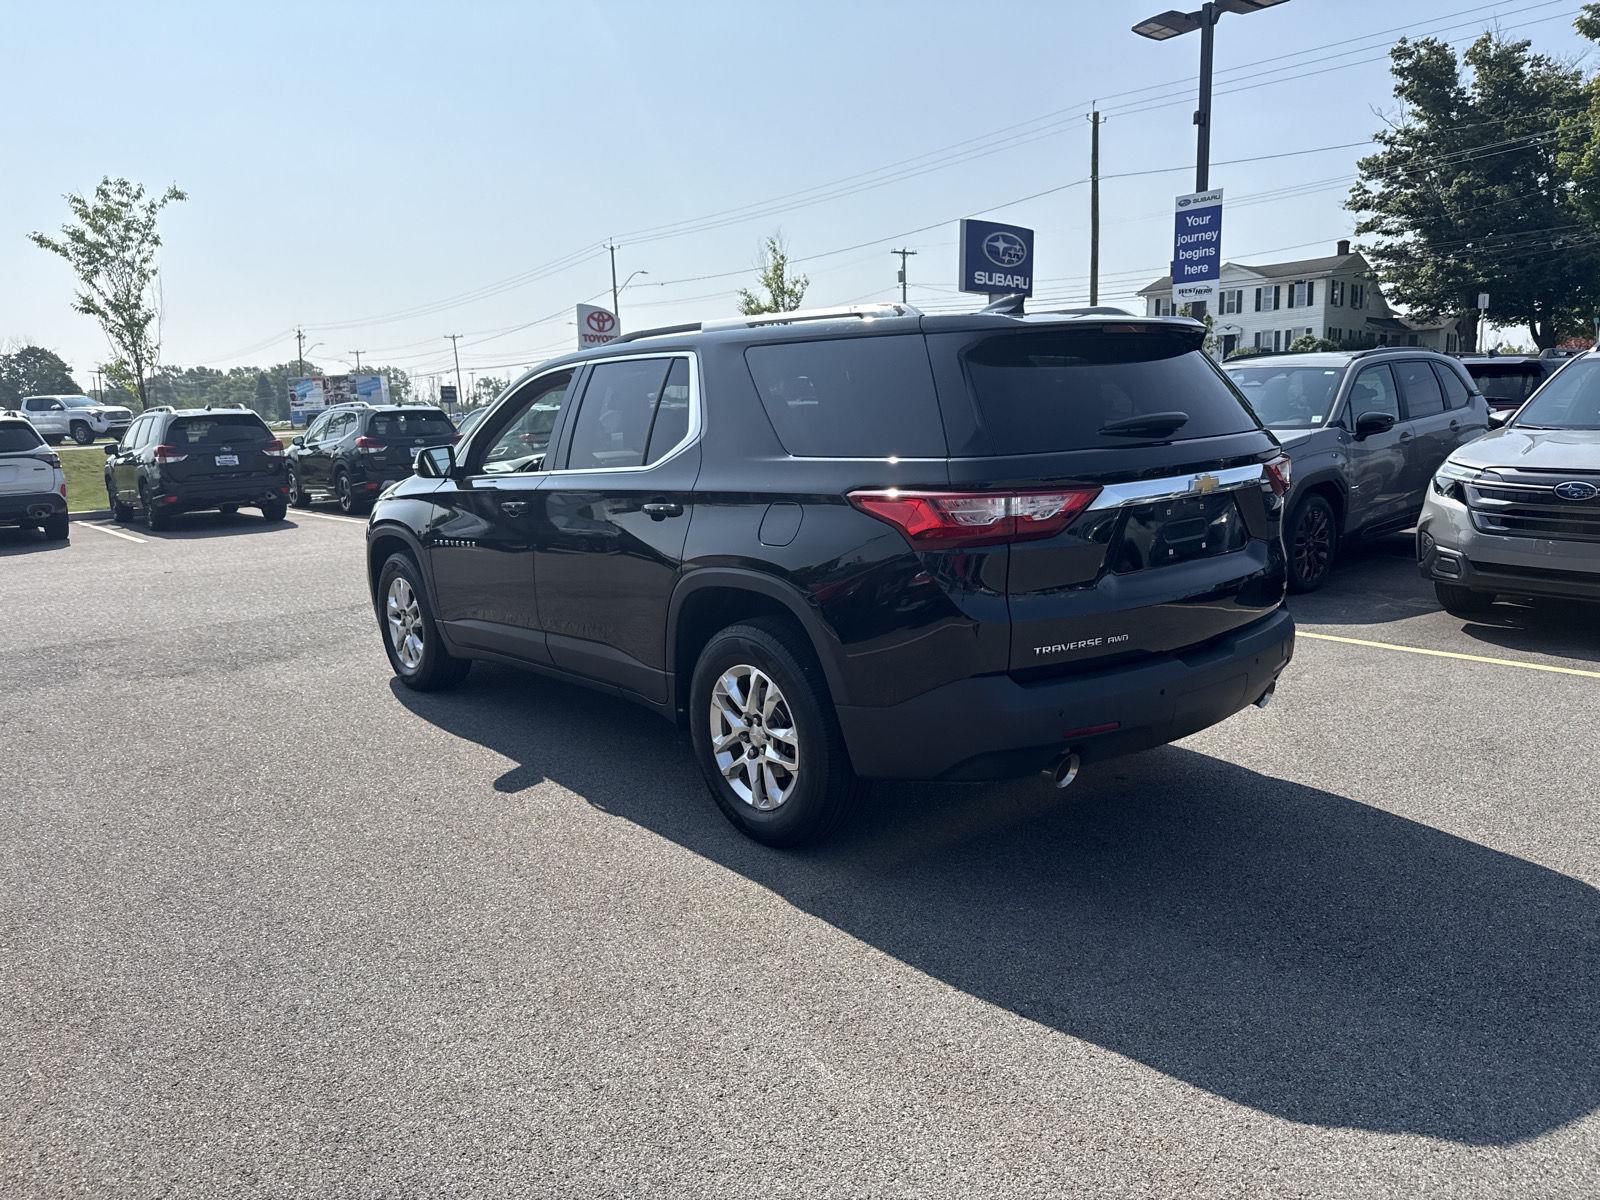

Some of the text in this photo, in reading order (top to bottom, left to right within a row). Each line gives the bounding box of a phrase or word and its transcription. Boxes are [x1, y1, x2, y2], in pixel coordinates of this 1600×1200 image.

[1192, 194, 1220, 203] SUBARU
[1186, 215, 1211, 227] Your
[1177, 230, 1219, 246] journey
[1179, 247, 1215, 260] begins
[1184, 264, 1208, 275] here
[974, 271, 1029, 289] SUBARU
[582, 334, 618, 343] TOYOT
[1033, 634, 1129, 655] TRAVERSE AWD
